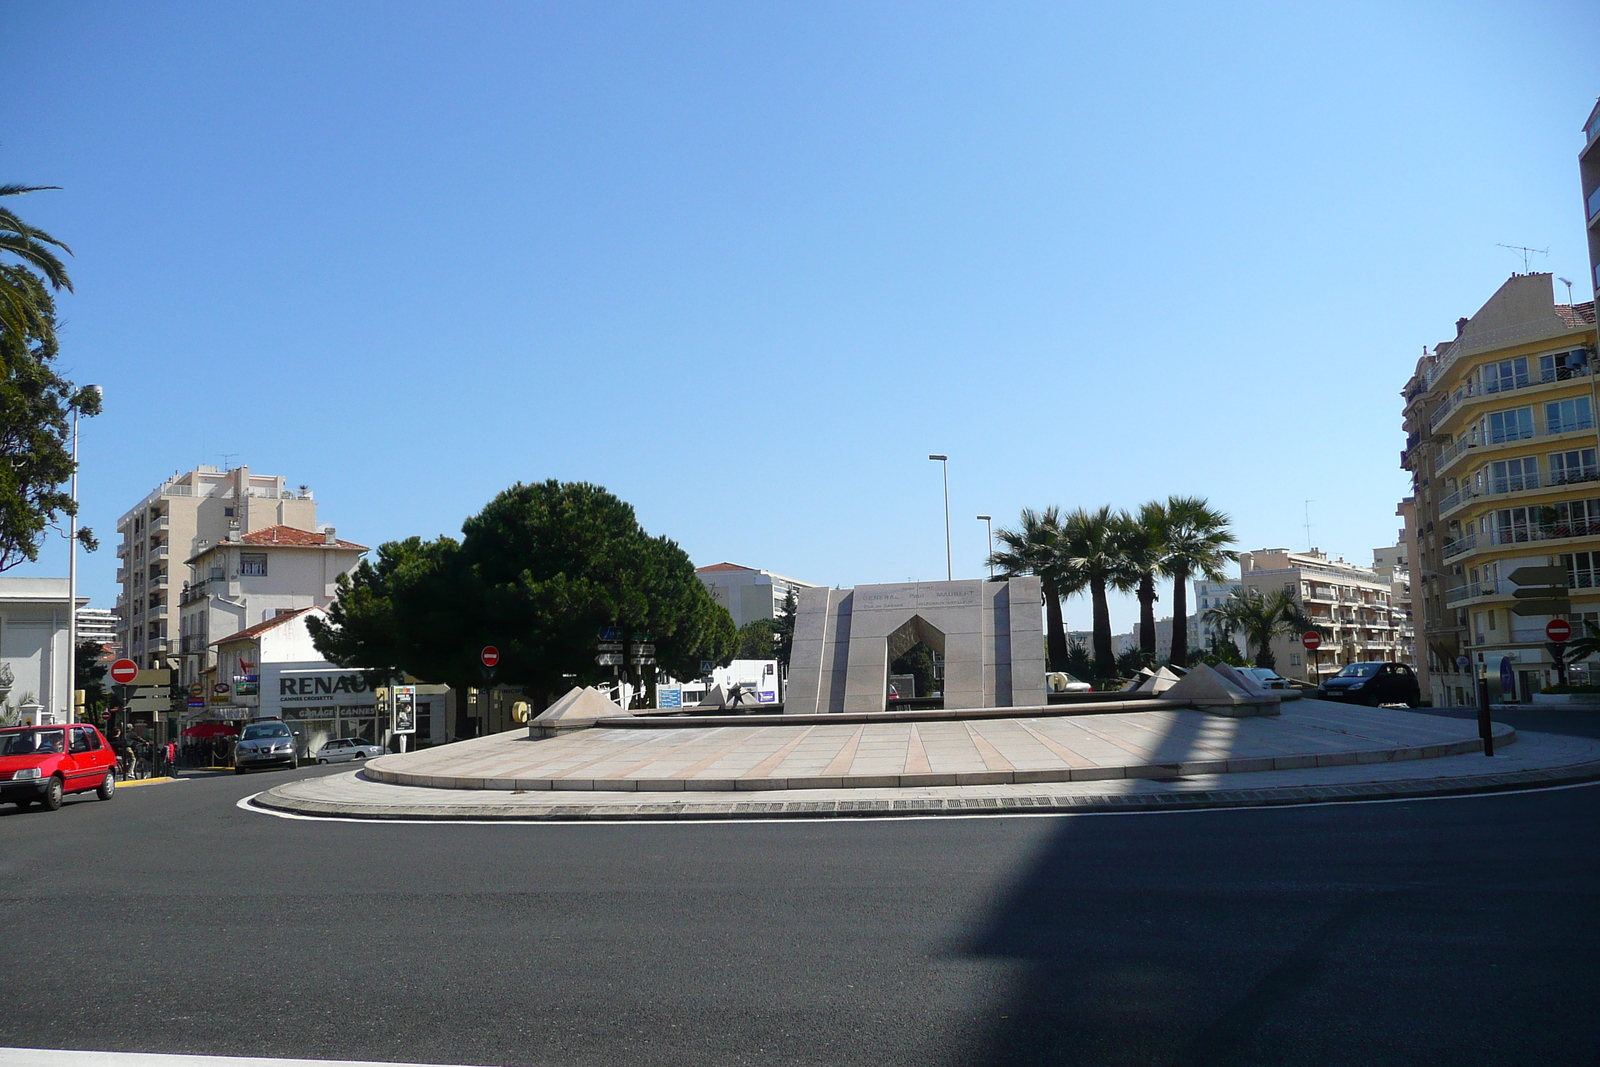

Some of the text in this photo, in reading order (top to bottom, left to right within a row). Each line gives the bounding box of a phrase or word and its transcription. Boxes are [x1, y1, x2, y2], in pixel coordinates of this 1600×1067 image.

[279, 675, 391, 695] RENAU
[298, 707, 375, 717] GARAGE CANNES
